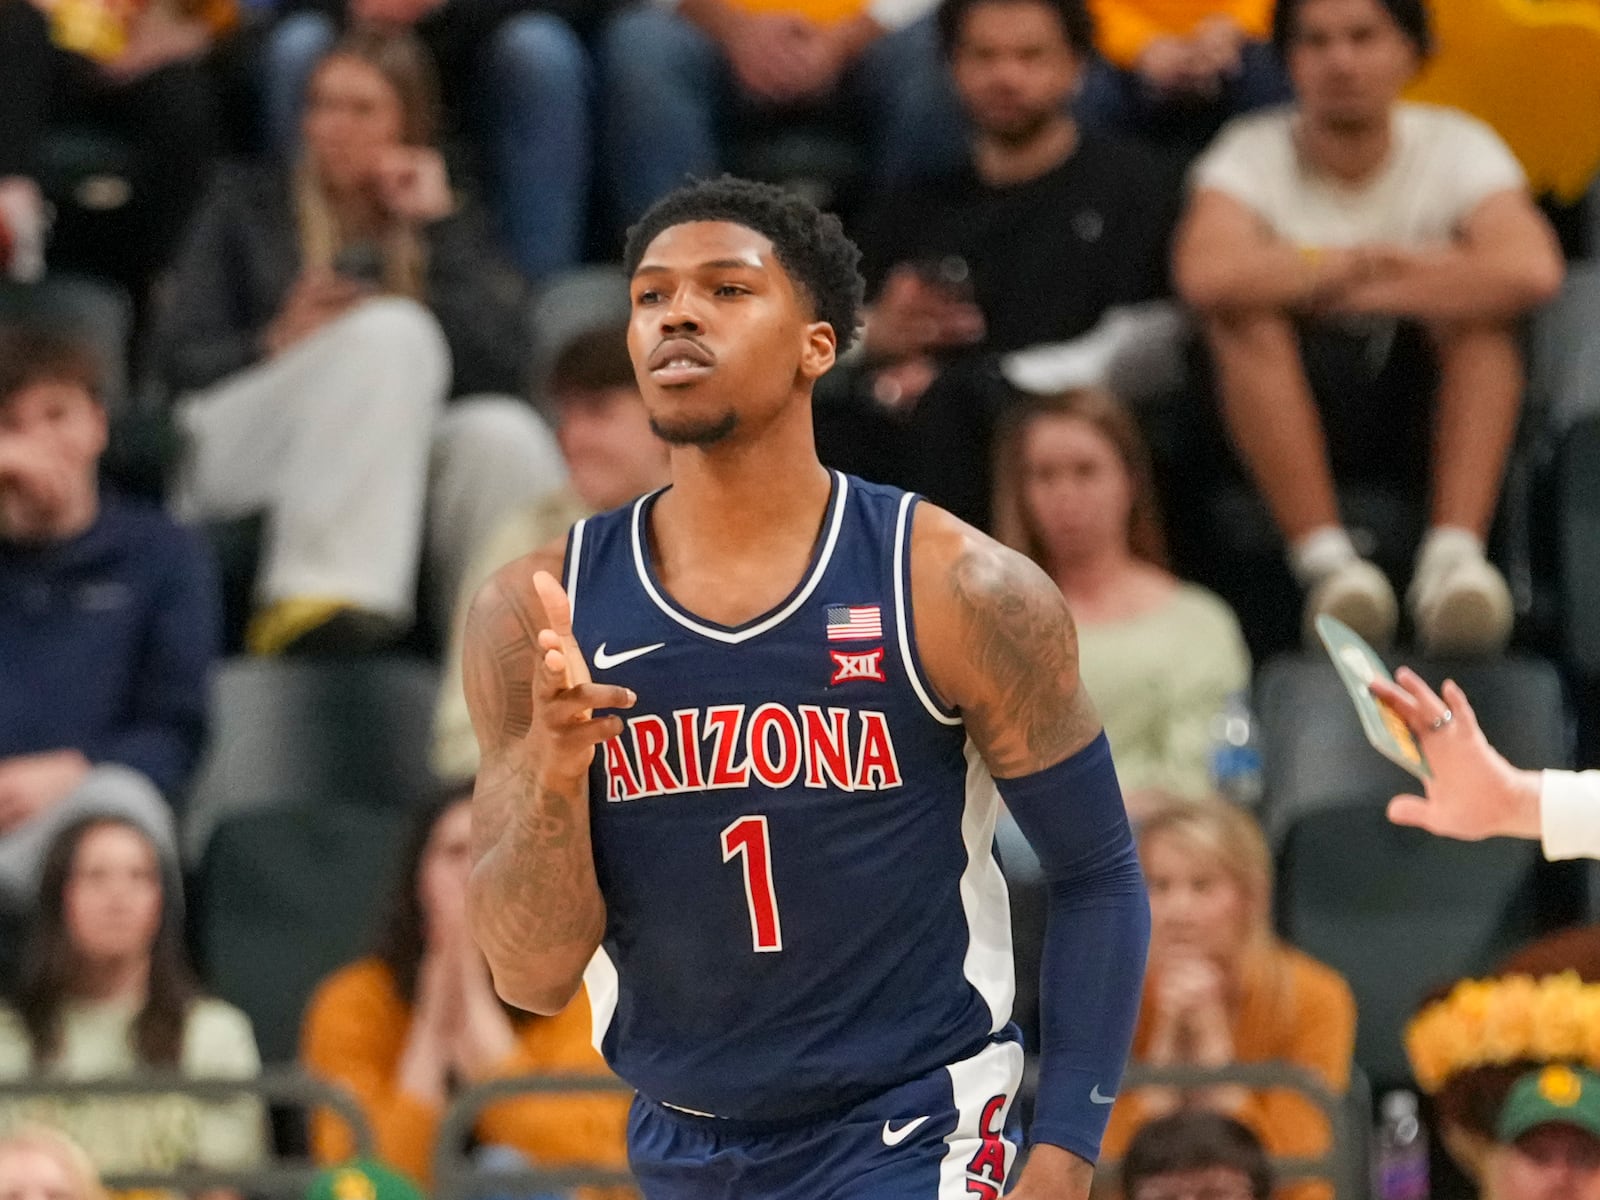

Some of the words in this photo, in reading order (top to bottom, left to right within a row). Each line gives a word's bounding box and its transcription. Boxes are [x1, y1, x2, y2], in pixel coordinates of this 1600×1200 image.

[831, 650, 884, 683] XII
[603, 702, 903, 803] ARIZONA
[720, 815, 782, 952] 1
